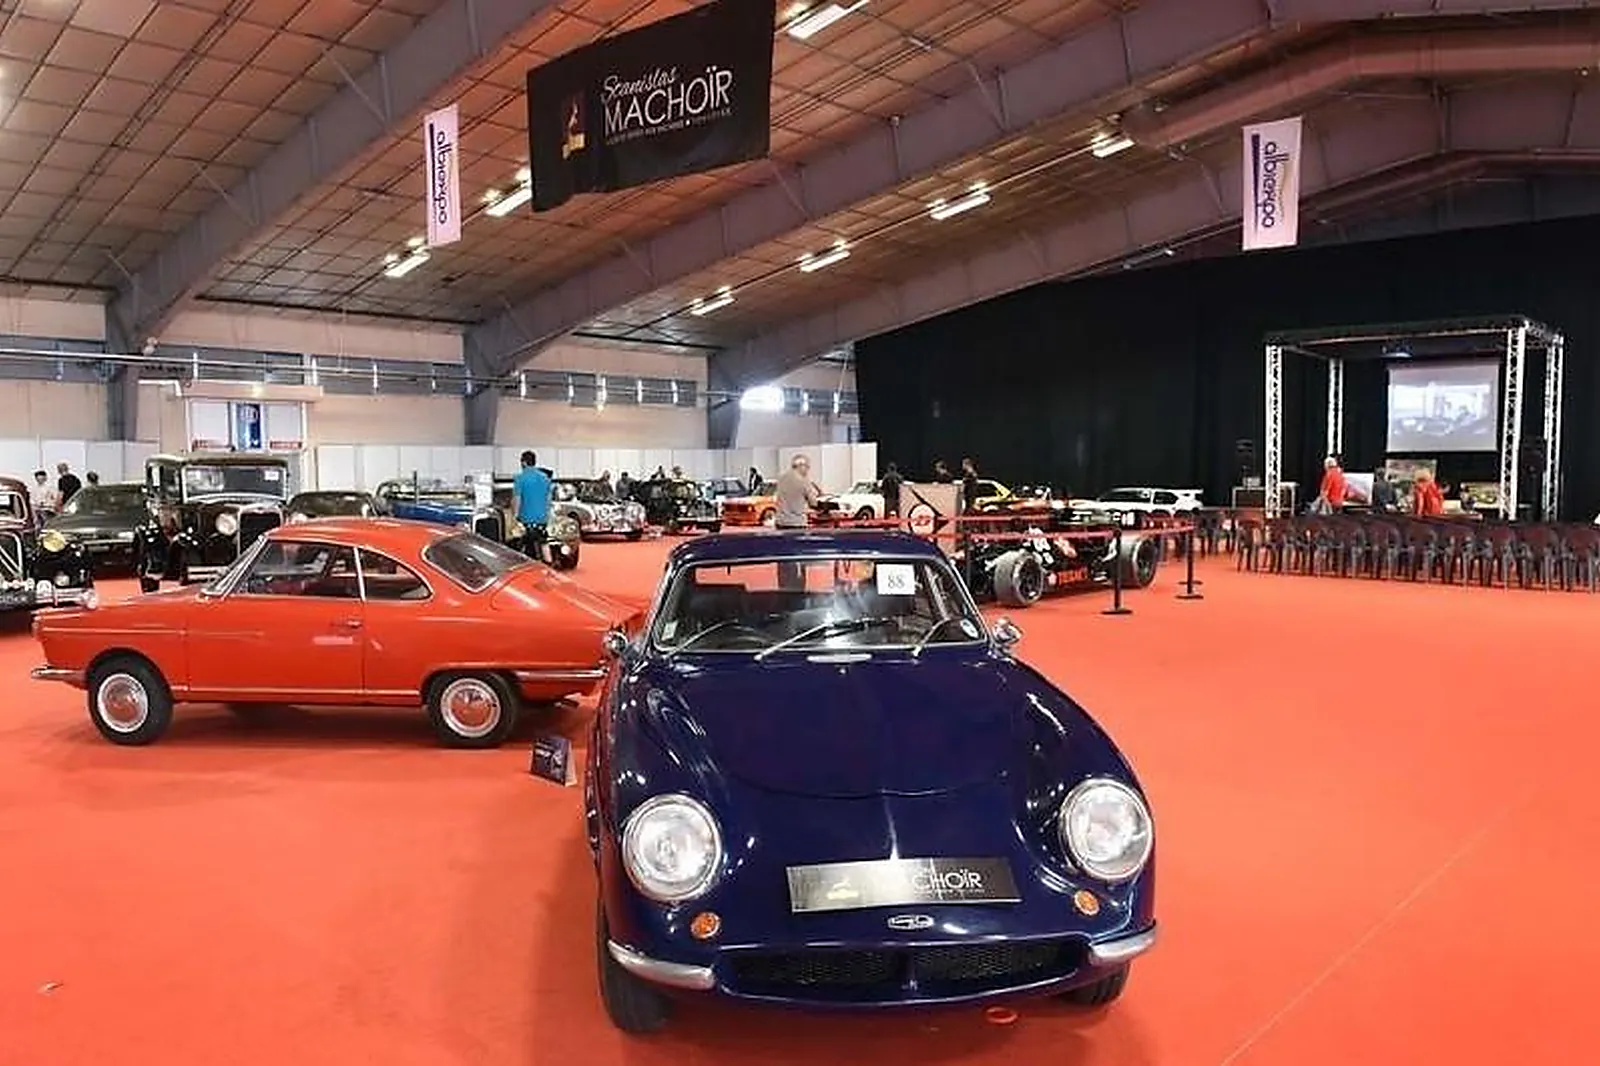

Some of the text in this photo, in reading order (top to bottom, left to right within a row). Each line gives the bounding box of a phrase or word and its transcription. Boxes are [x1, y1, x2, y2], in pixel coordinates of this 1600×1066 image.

[602, 65, 733, 137] MACHOÏR
[1257, 142, 1289, 228] albiexpo
[887, 573, 905, 589] 88
[912, 867, 983, 889] CHOÏR
